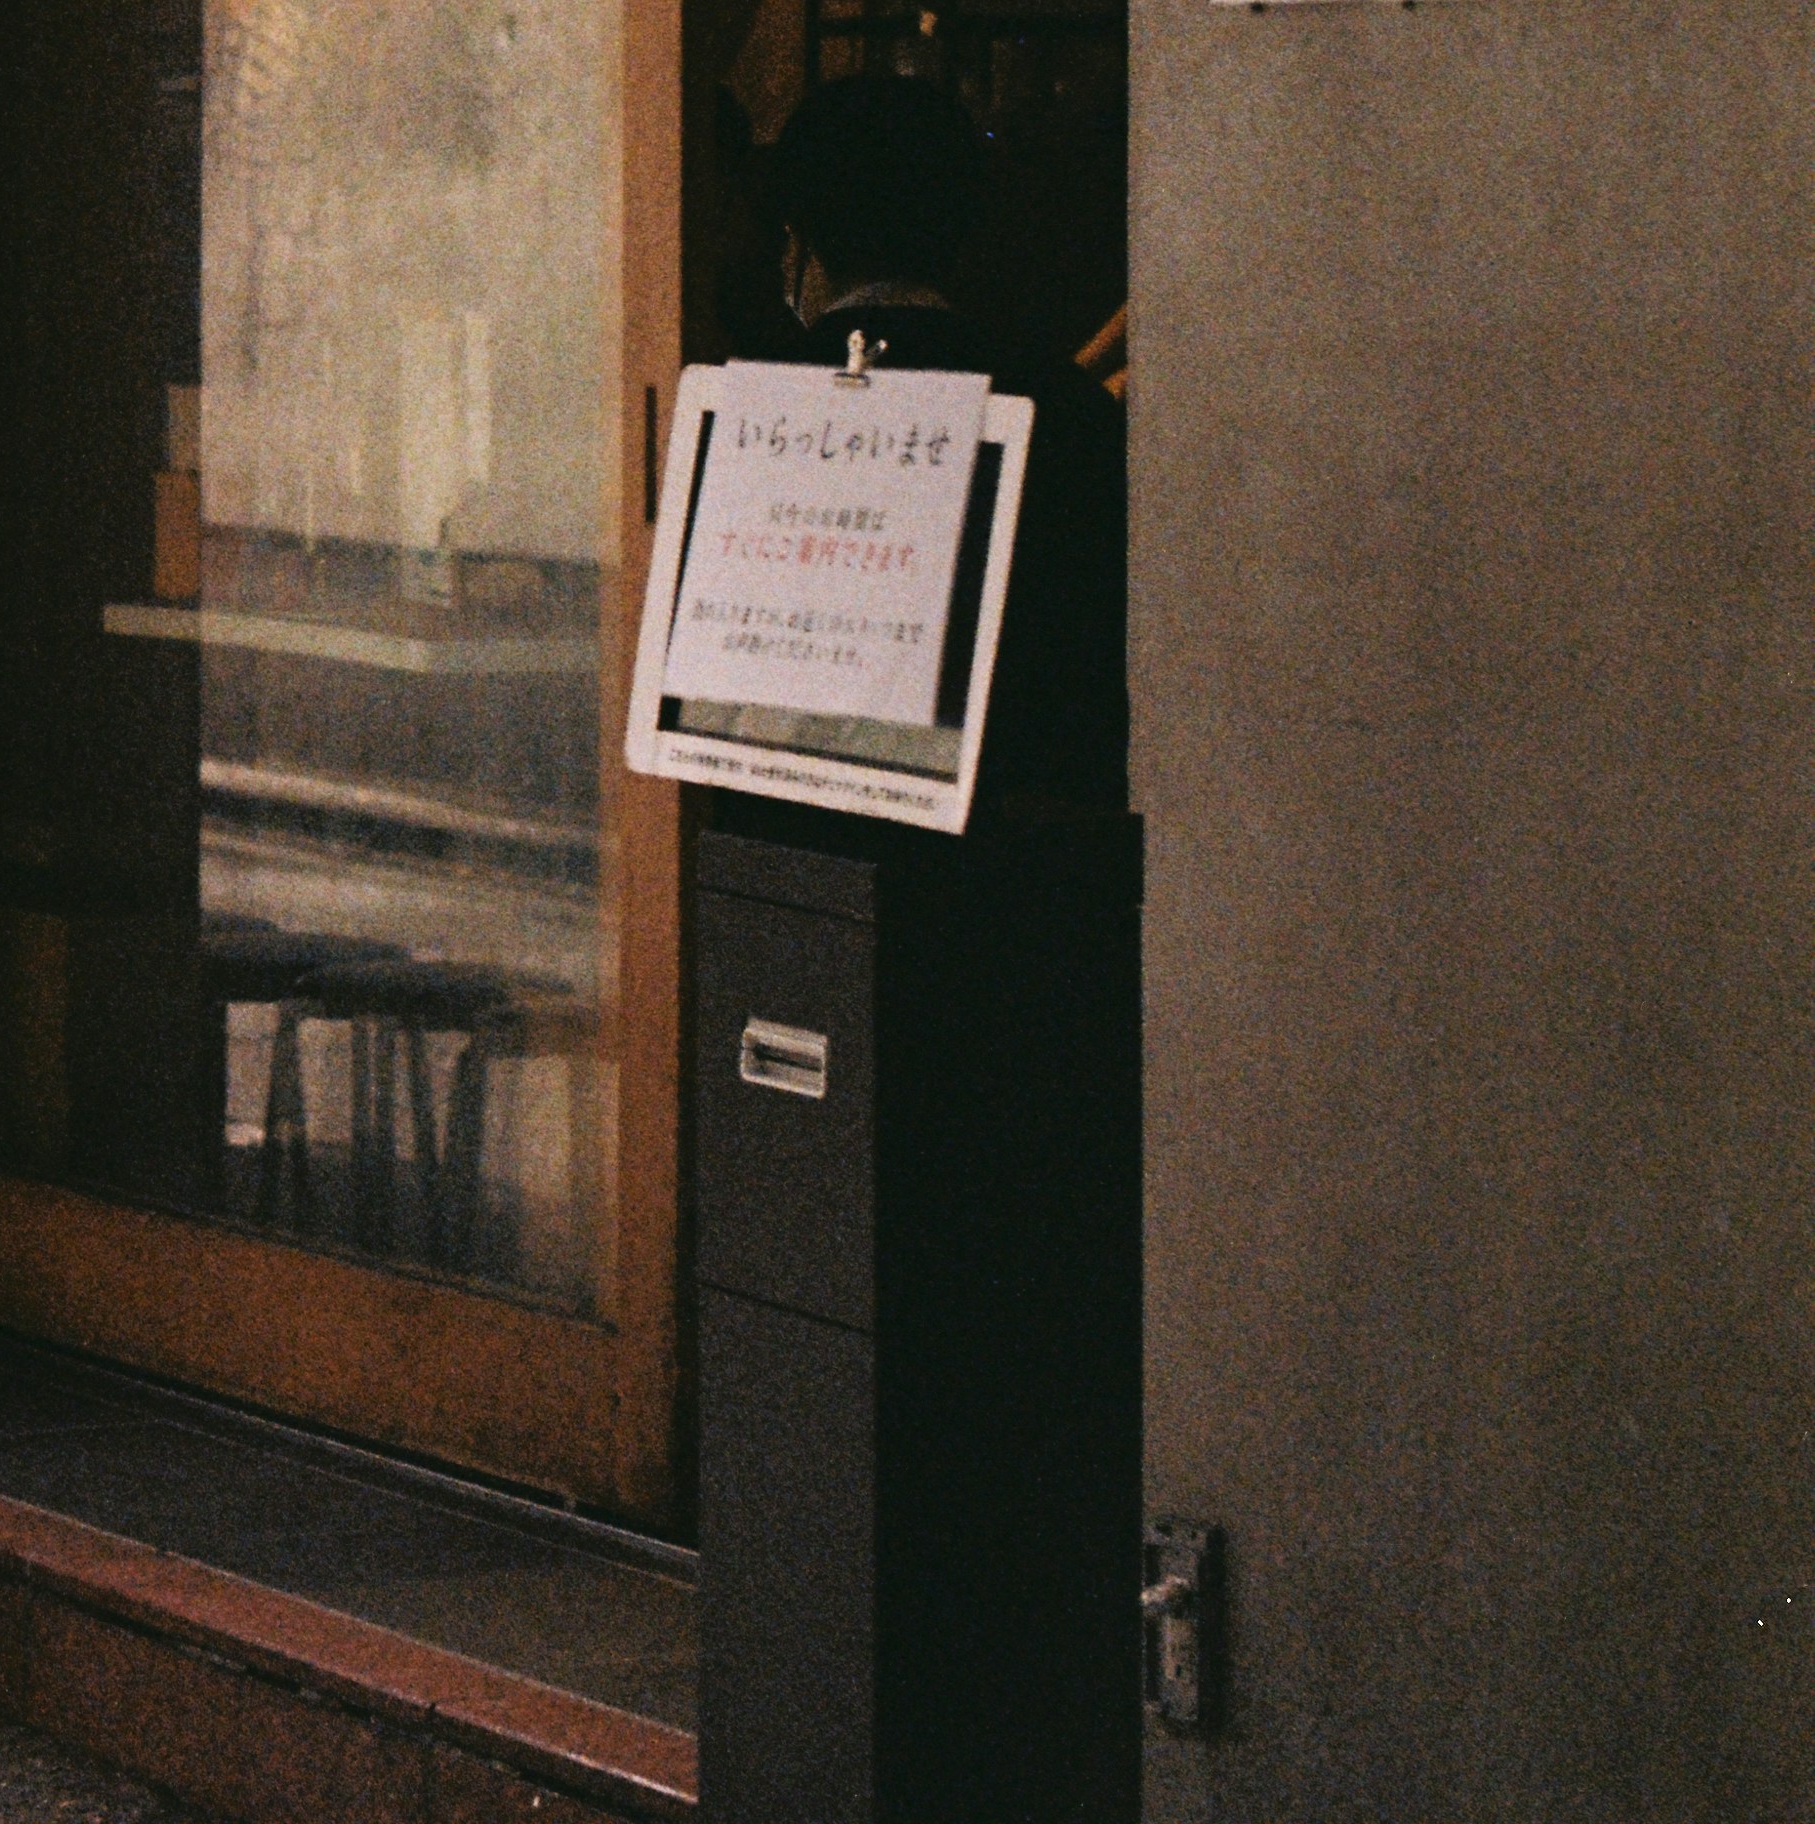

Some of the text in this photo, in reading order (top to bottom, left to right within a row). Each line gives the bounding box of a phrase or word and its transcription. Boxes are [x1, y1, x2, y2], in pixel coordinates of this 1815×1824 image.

[737, 415, 951, 467] いらっしゃいませ
